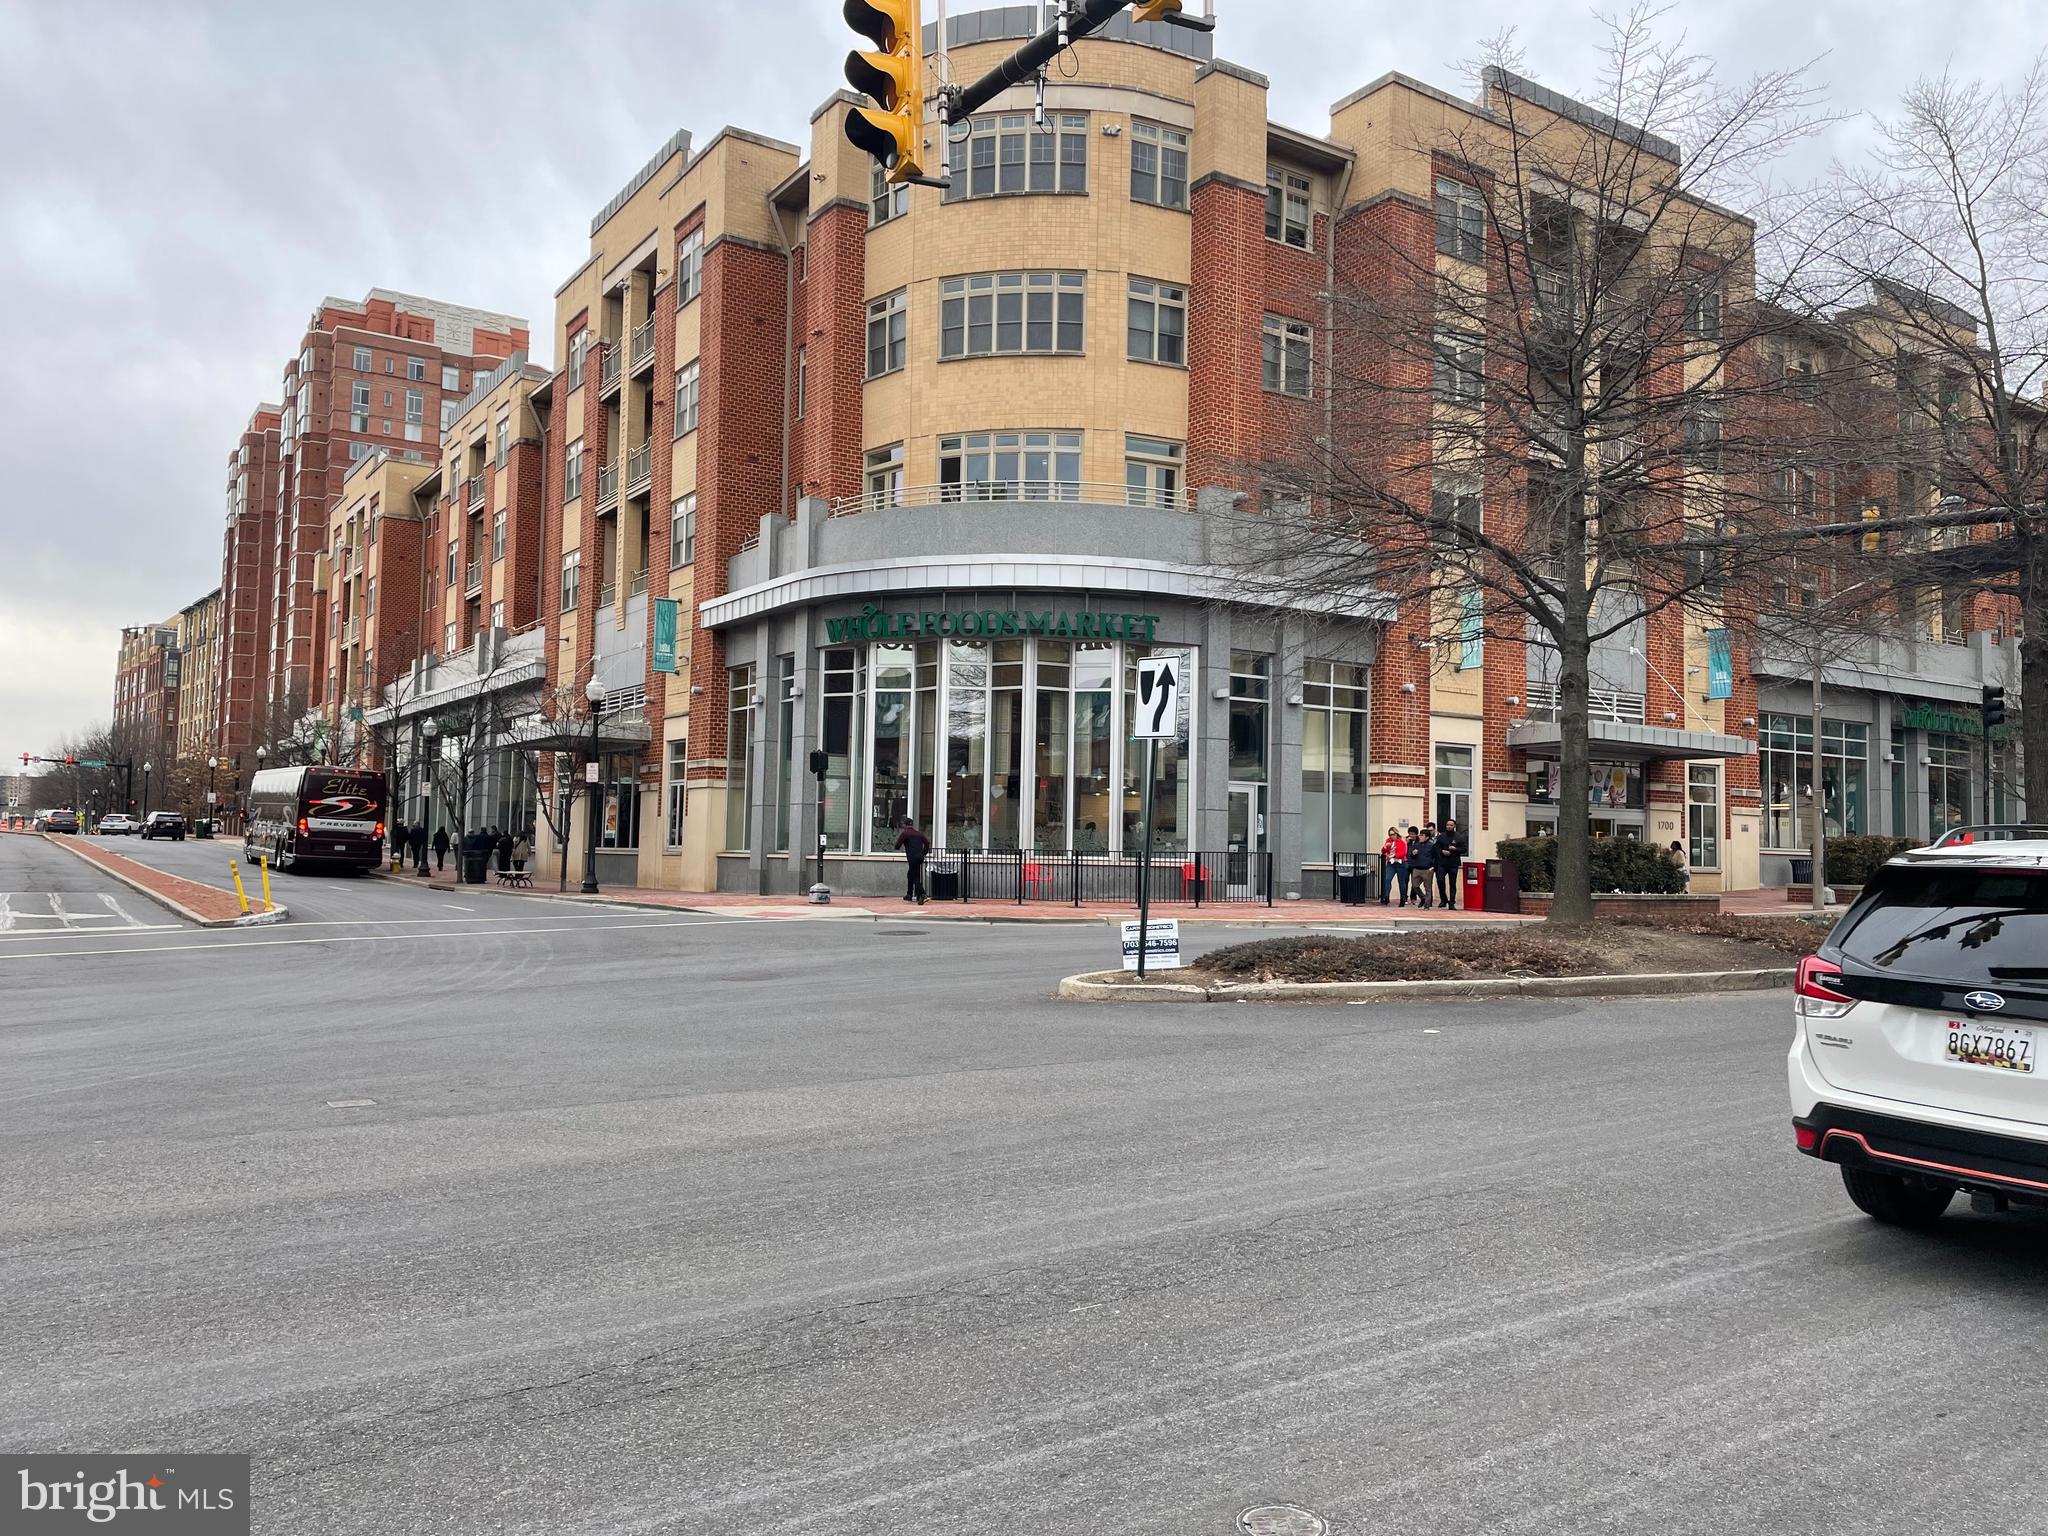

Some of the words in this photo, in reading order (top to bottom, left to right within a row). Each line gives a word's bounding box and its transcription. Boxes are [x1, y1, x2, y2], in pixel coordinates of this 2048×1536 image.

[825, 605, 915, 642] WHOLE
[919, 609, 1020, 638] FOODS
[1024, 610, 1160, 641] MARKET
[1658, 821, 1674, 830] 1700
[1948, 1032, 2029, 1061] 8GX7867
